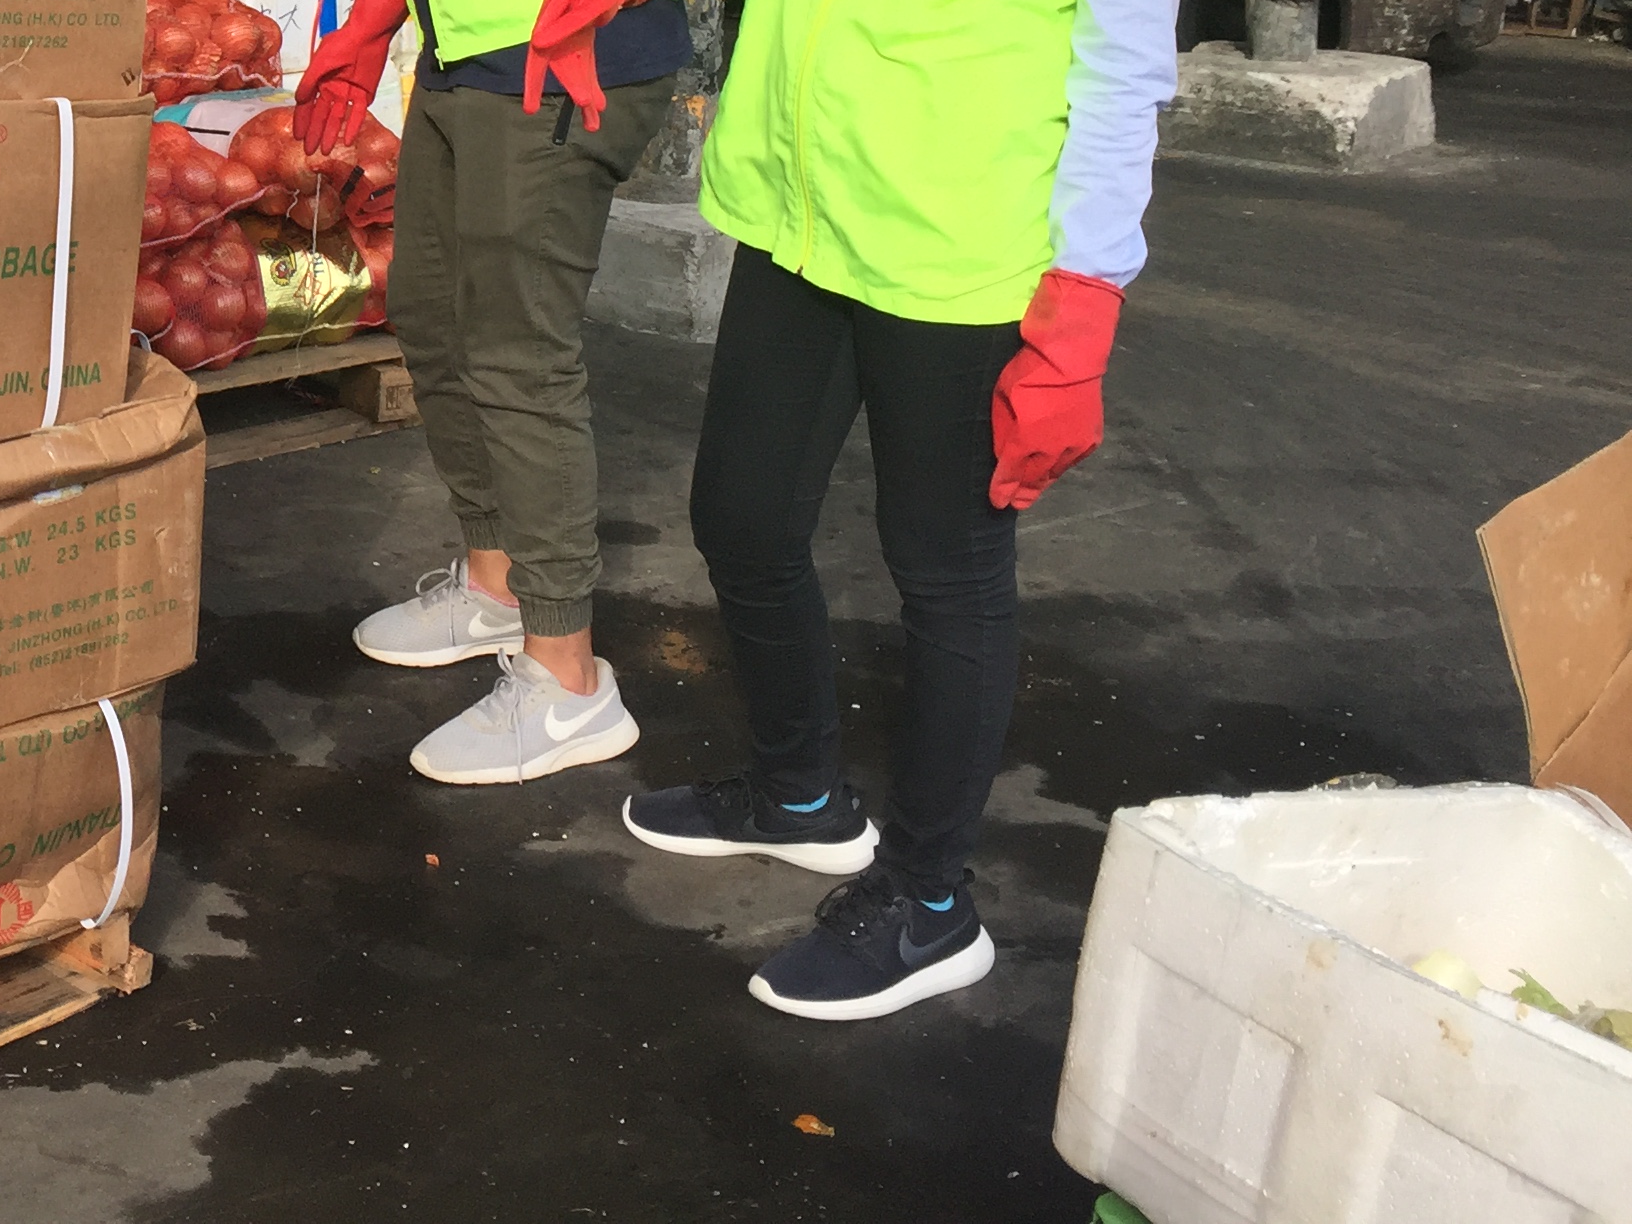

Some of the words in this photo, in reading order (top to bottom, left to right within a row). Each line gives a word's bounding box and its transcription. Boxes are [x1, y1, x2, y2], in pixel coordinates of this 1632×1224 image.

[26, 12, 62, 28] (H.K)
[47, 516, 86, 541] 24.5
[95, 503, 137, 527] KGS
[57, 544, 80, 565] 23
[95, 529, 137, 552] KGS
[8, 623, 83, 652] JINZHONG
[32, 803, 121, 858] TIANJIN
